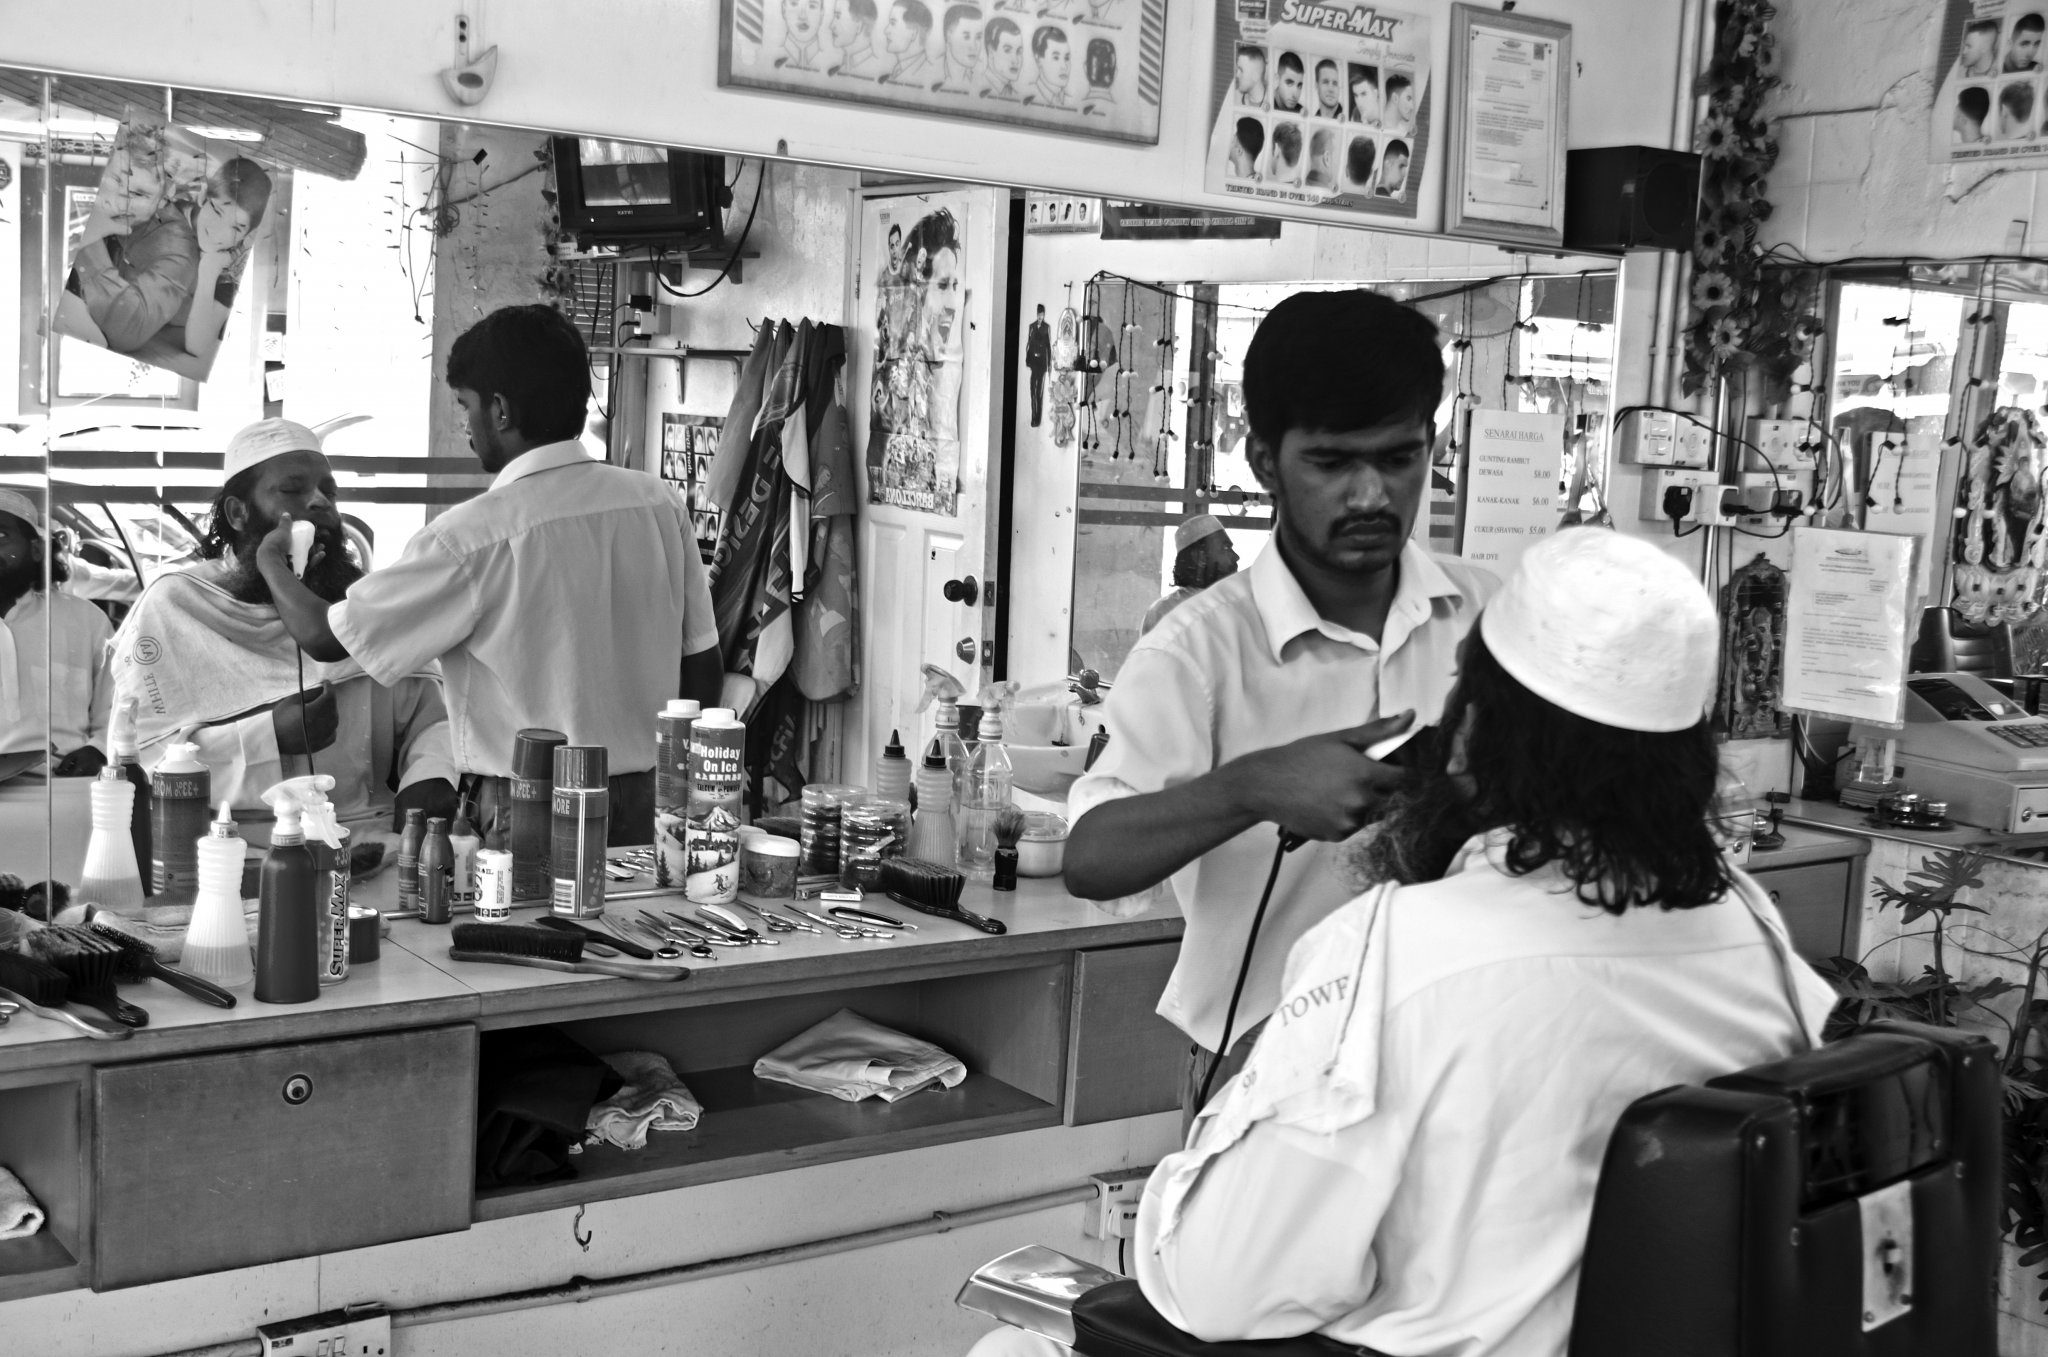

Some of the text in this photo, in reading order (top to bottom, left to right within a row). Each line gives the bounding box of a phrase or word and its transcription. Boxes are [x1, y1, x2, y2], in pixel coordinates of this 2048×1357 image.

[1484, 429, 1544, 441] SENARAI HARGA
[1479, 455, 1530, 465] GUNTING RAMBUT
[1478, 469, 1504, 477] DEWASA
[1477, 496, 1549, 506] KANAK-KANAK $6.00
[1493, 526, 1524, 535] (SHAVING)
[1528, 527, 1546, 536] $5.00
[1470, 553, 1499, 561] HAIR DYE
[701, 746, 740, 760] Holiday
[703, 759, 738, 773] On Ice
